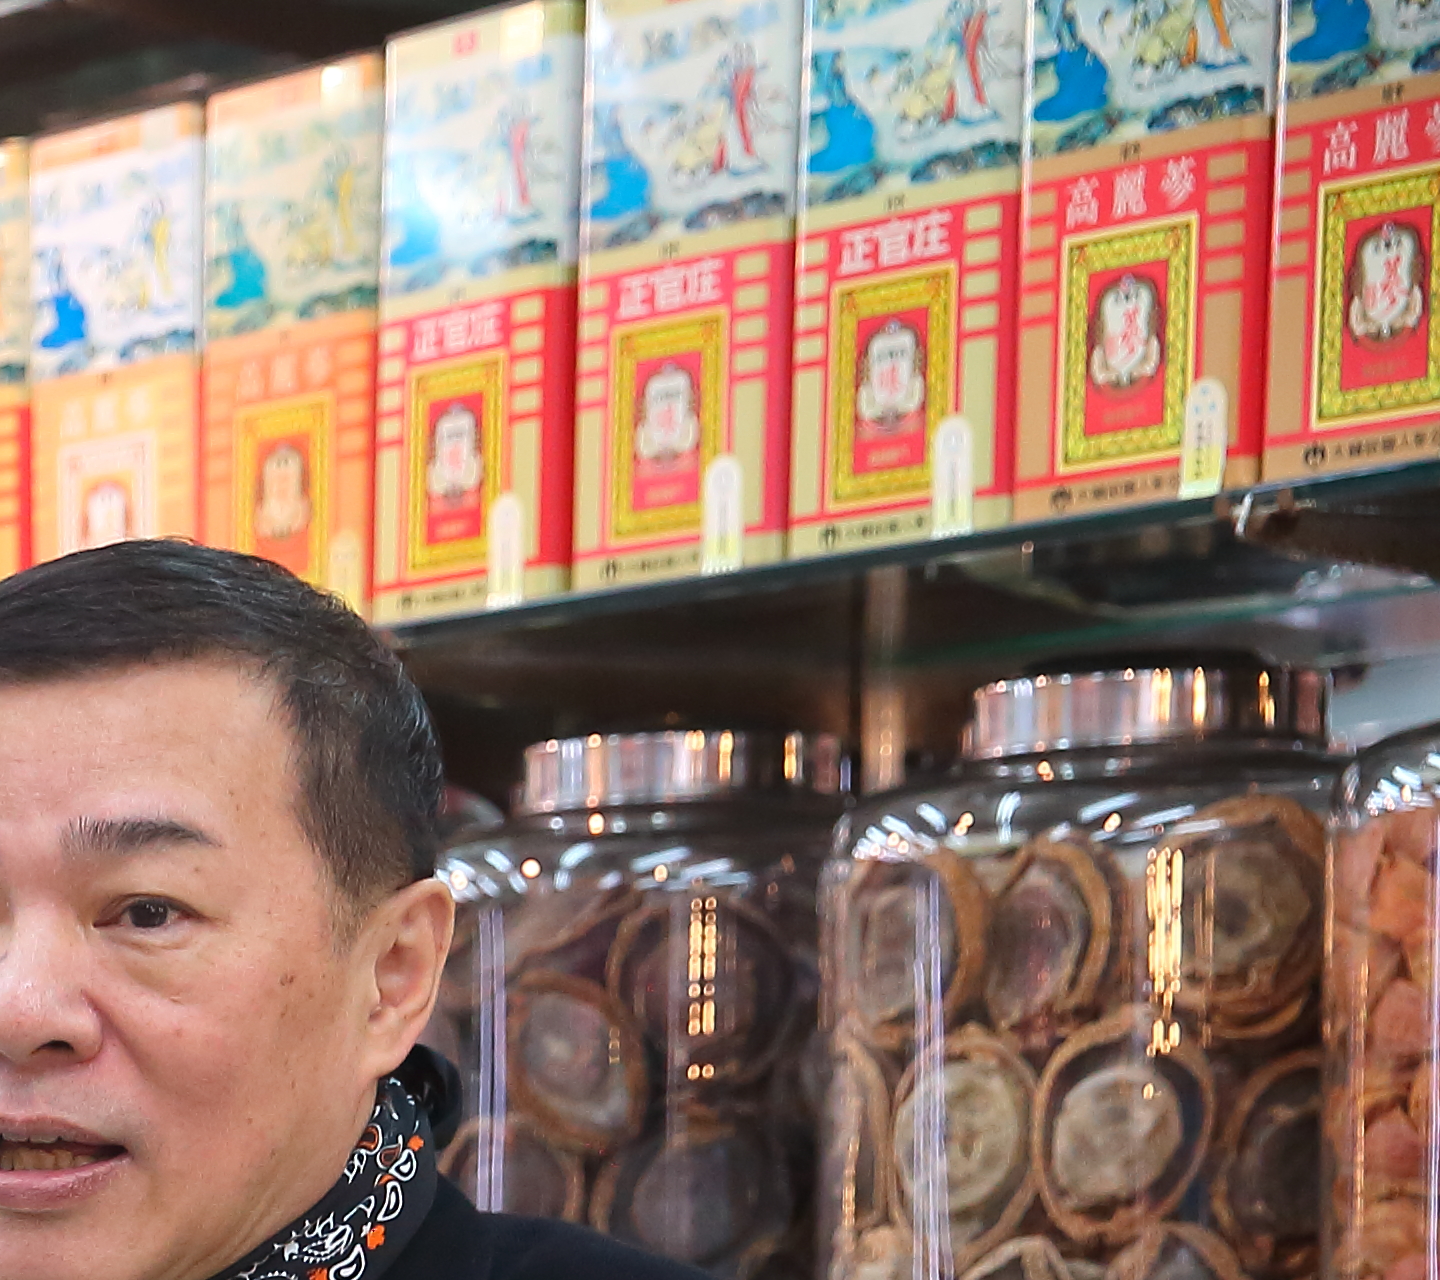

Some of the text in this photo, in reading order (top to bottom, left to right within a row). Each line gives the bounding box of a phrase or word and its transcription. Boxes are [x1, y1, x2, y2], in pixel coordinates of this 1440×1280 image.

[839, 209, 953, 275] 正官庄
[619, 259, 725, 319] 正官庄
